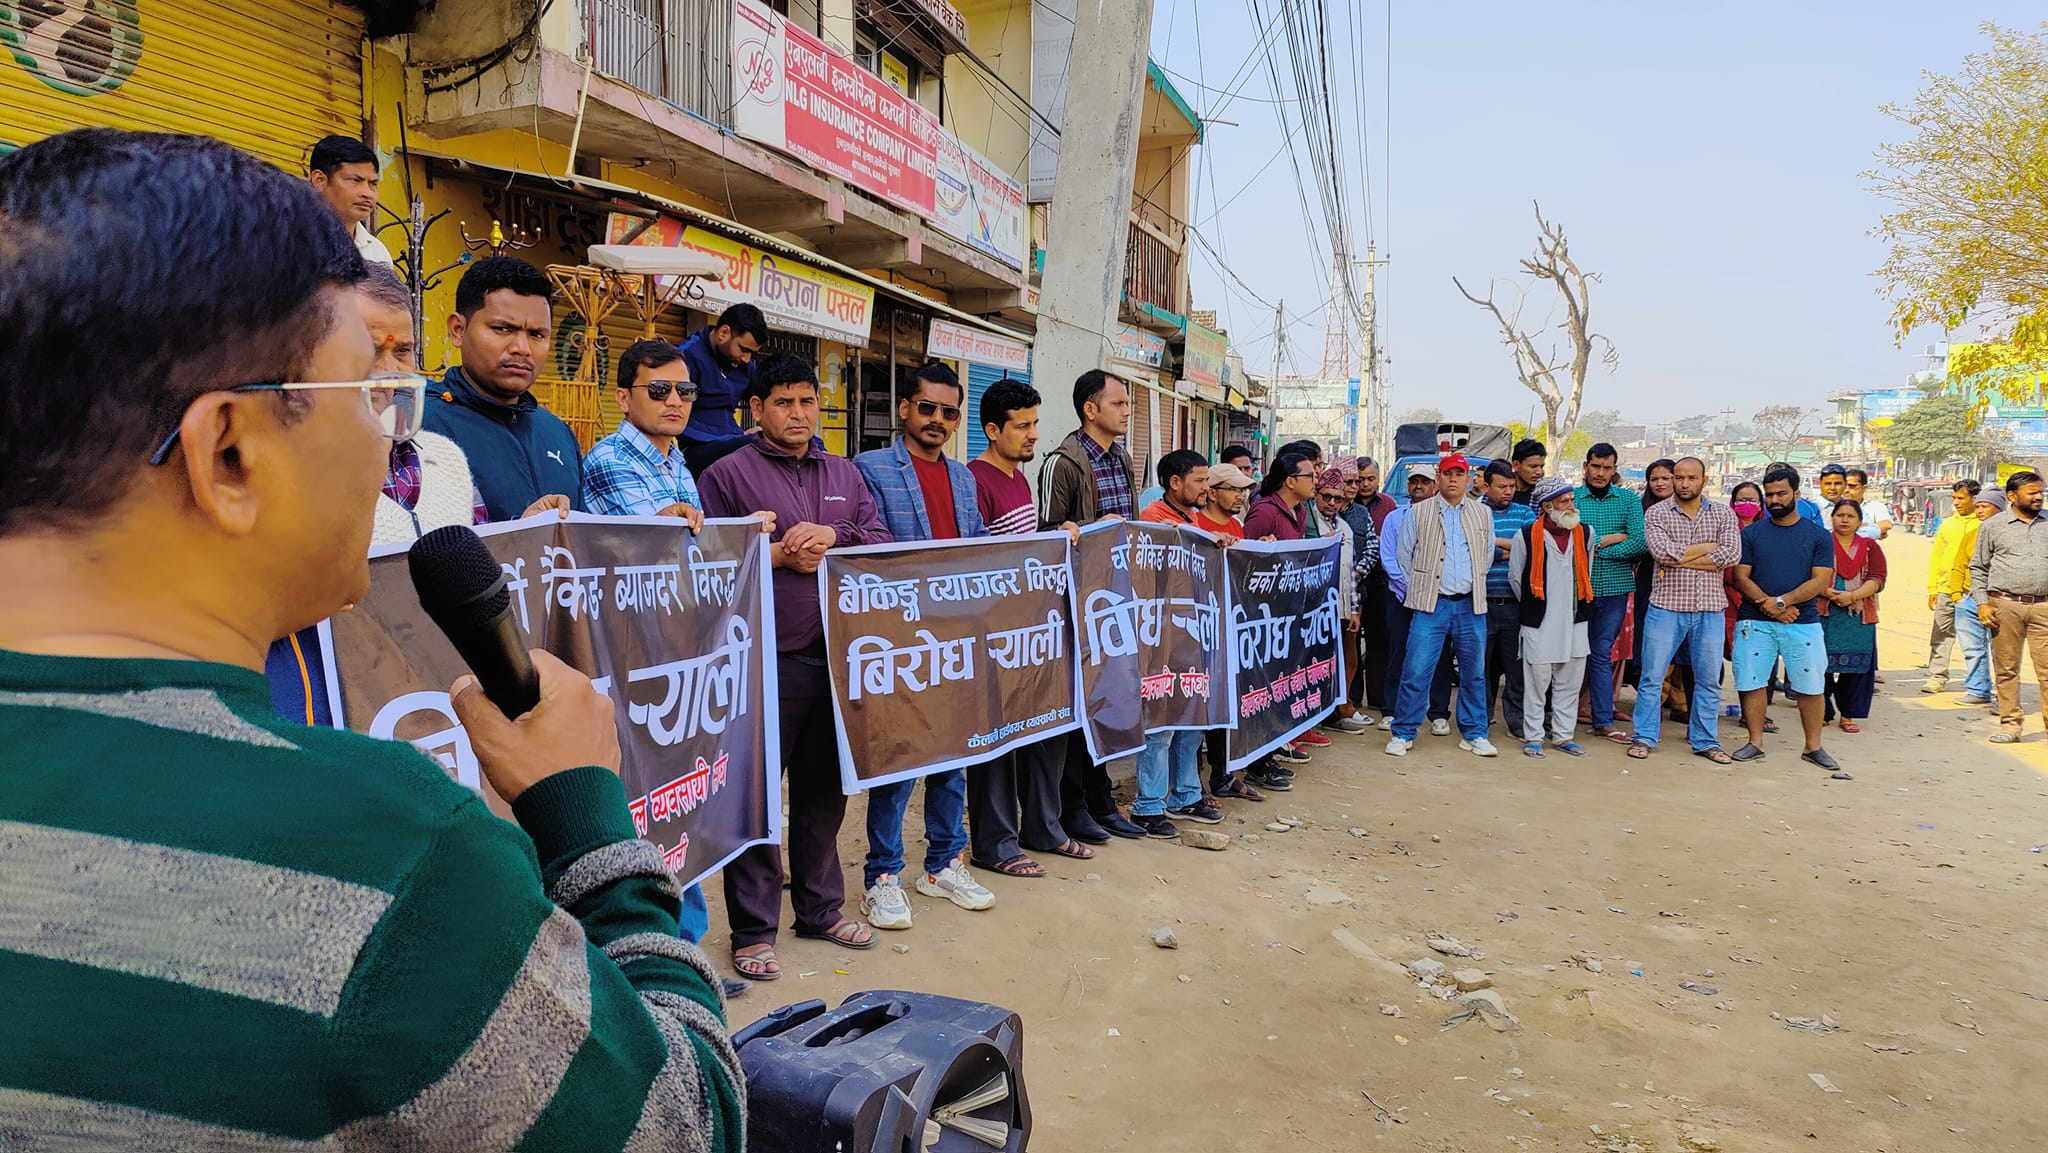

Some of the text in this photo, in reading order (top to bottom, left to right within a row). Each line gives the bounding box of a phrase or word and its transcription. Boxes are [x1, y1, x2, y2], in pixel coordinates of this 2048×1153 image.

[785, 77, 808, 111] NLG
[810, 92, 865, 143] INSURANCE
[866, 124, 906, 164] COMPANY
[907, 147, 936, 180] LIMITED
[759, 254, 822, 313] किराना
[826, 285, 868, 325] पसल
[846, 629, 977, 701] बिरोध
